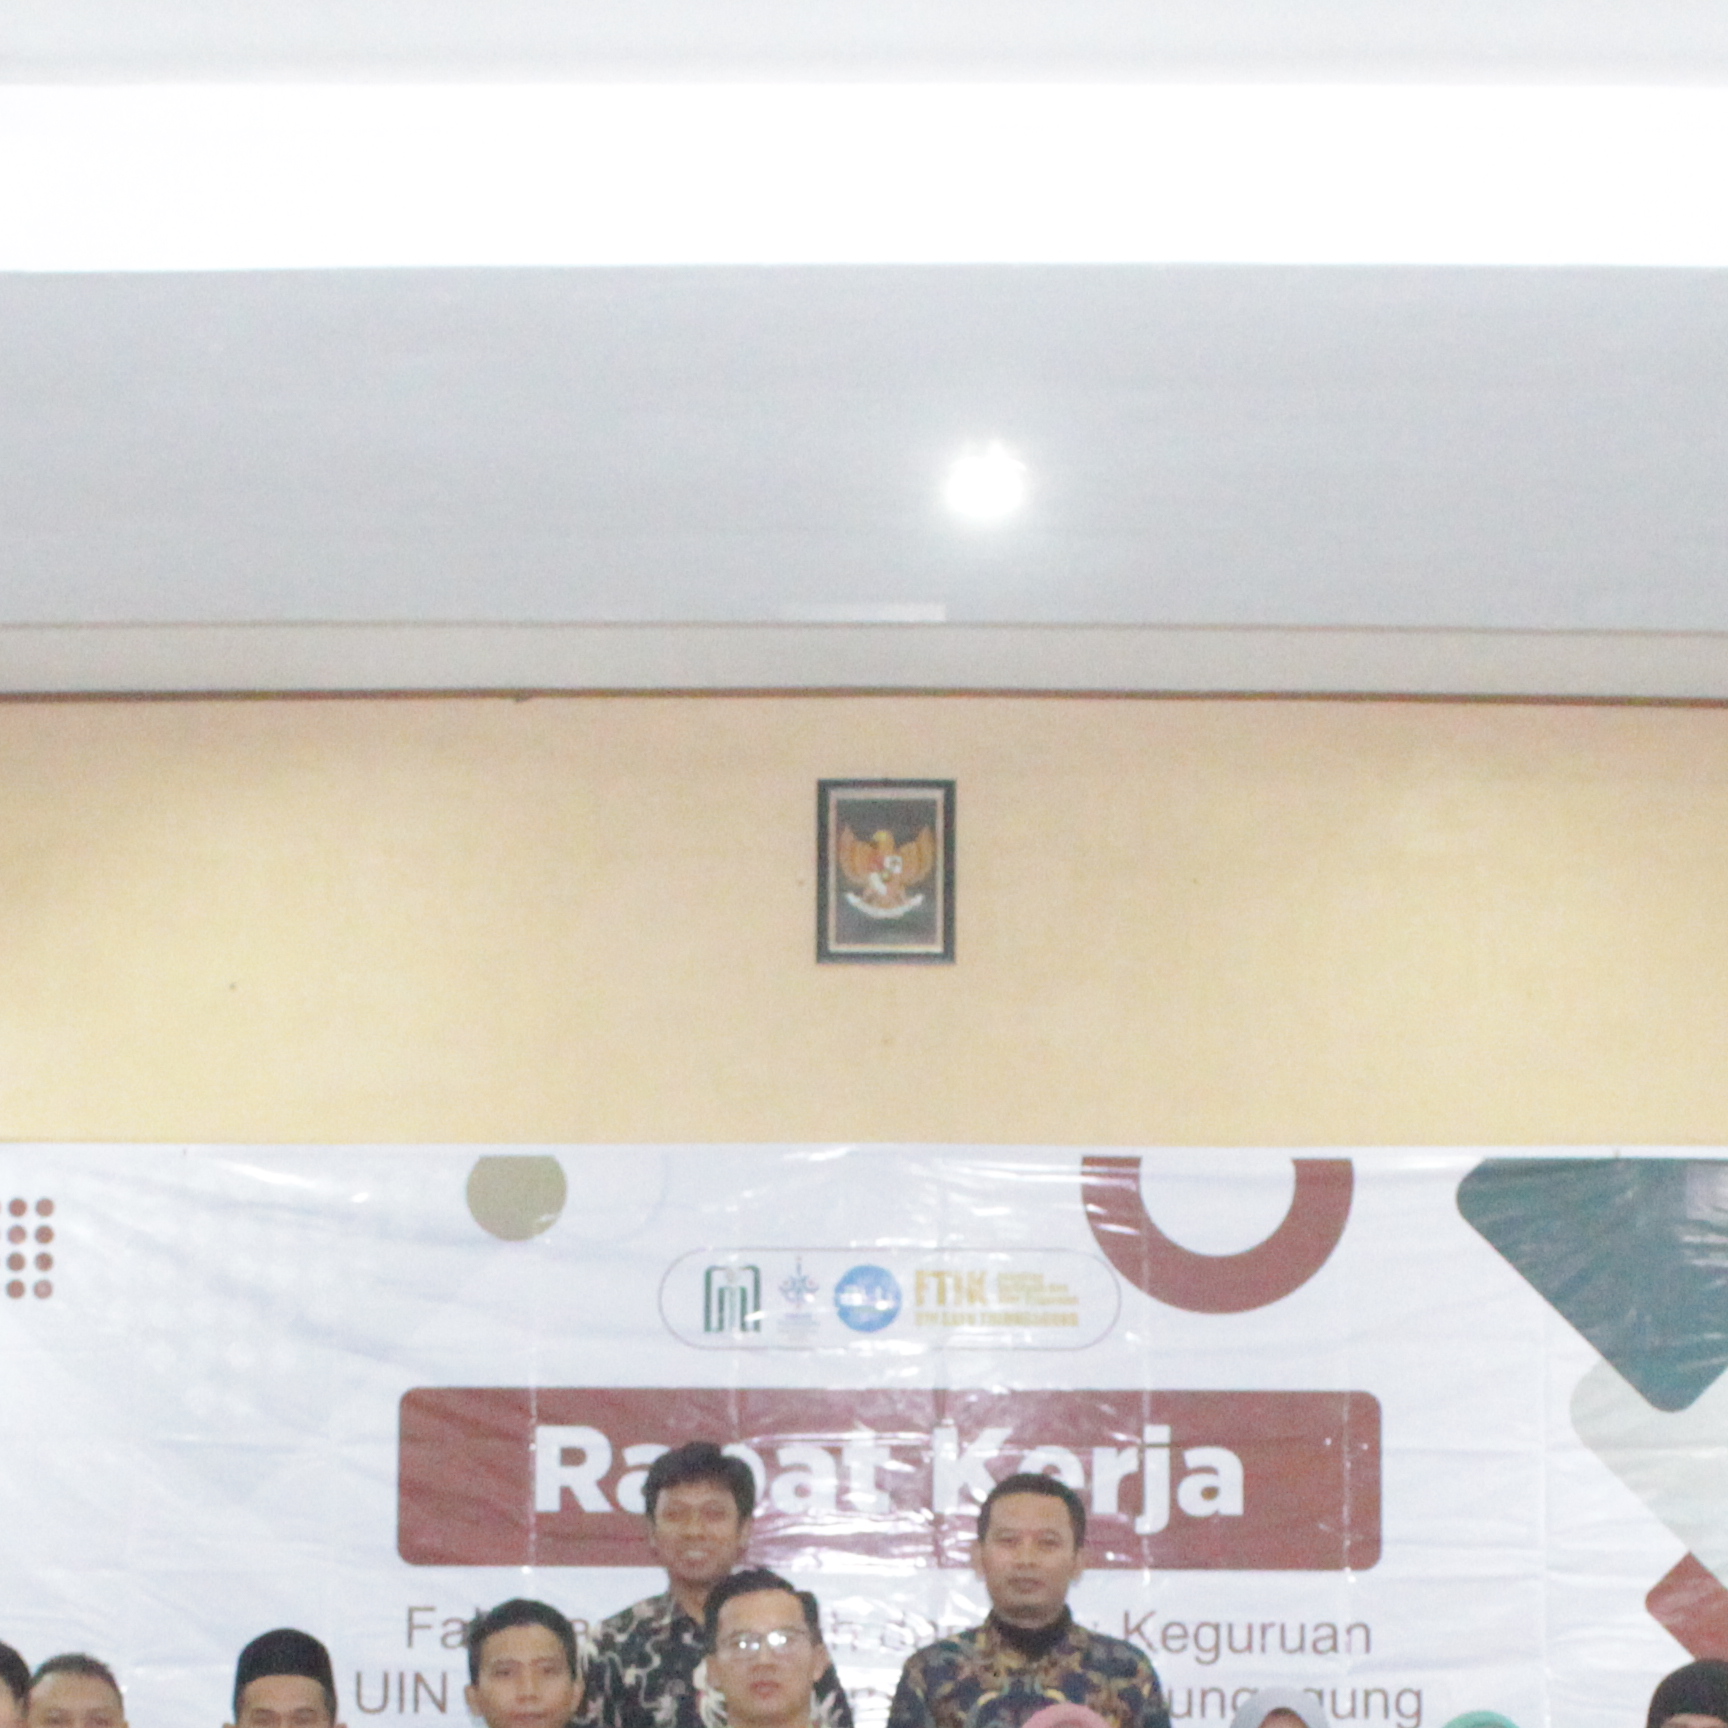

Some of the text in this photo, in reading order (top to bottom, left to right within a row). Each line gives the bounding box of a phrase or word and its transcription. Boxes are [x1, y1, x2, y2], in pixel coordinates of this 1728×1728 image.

[534, 1424, 891, 1515] Raat
[1123, 1610, 1372, 1665] Keguruan
[356, 1671, 448, 1714] UIN
